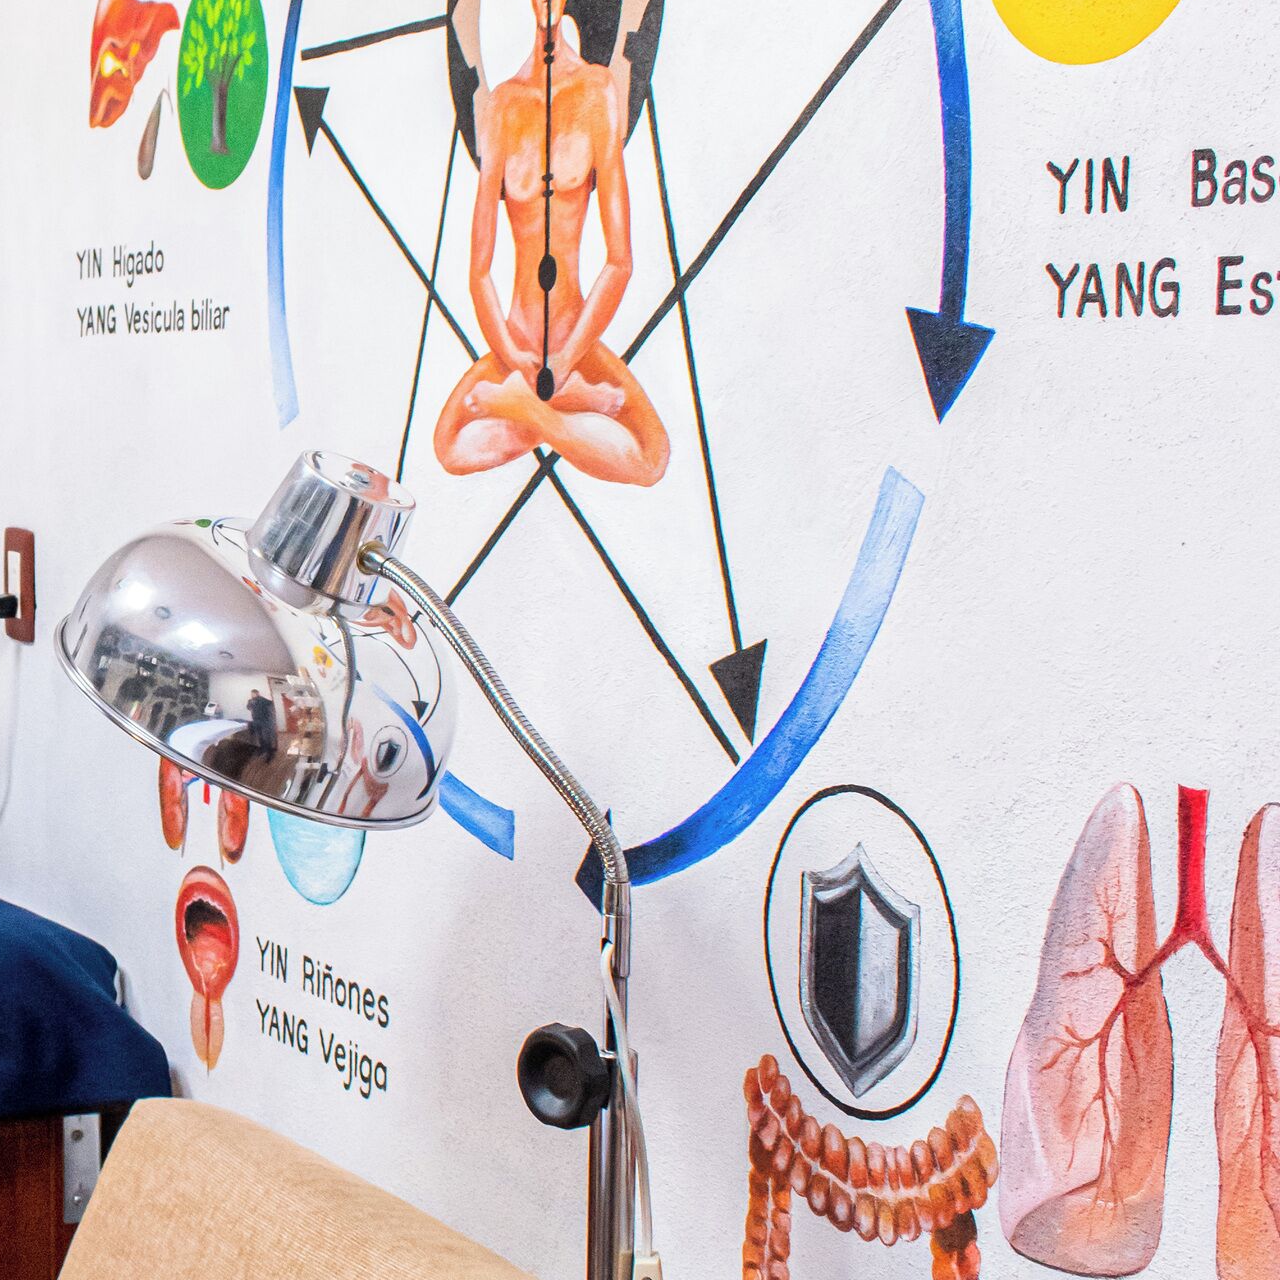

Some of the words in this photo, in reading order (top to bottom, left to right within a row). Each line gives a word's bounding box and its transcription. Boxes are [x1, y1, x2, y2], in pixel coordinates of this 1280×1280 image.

[1046, 155, 1130, 214] YIN
[1191, 148, 1280, 208] Bas
[76, 247, 102, 280] YIN
[1045, 257, 1180, 318] YANG
[1215, 255, 1280, 316] Es
[77, 304, 117, 337] YANG
[191, 298, 231, 331] biliar
[256, 936, 287, 983] YIN
[303, 955, 390, 1028] Riñones
[256, 998, 308, 1055] YANG
[319, 1027, 388, 1099] Vejiga
